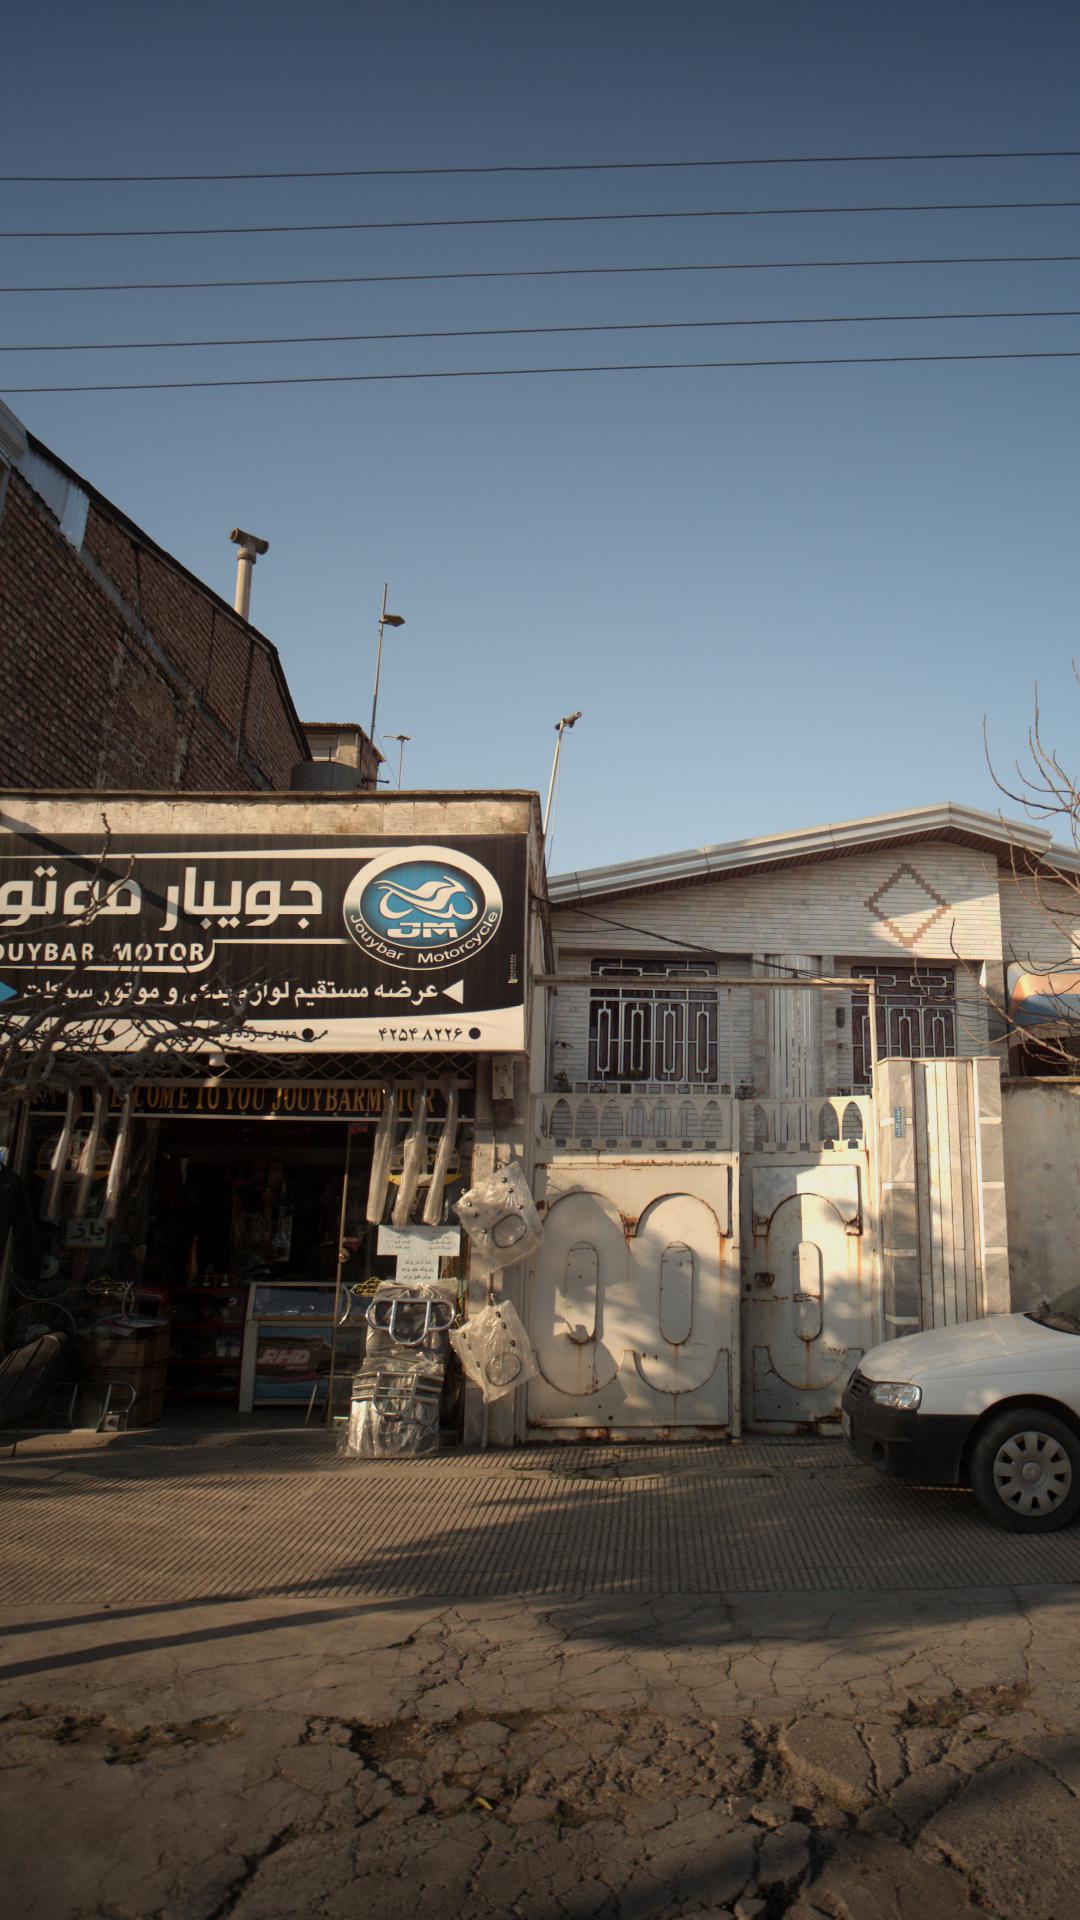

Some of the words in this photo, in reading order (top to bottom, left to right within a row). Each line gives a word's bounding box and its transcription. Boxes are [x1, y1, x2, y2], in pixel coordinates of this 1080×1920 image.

[158, 866, 323, 932] جویبار
[350, 914, 406, 961] Jouybar
[417, 911, 499, 964] Motorcycle
[387, 922, 459, 938] JM
[0, 943, 94, 962] UYBAR
[112, 943, 204, 962] MOTOR
[164, 987, 178, 1006] و
[295, 980, 369, 1008] مستقیم
[374, 980, 439, 1006] عرضه
[196, 1086, 220, 1110] TO
[225, 1086, 265, 1111] YOU
